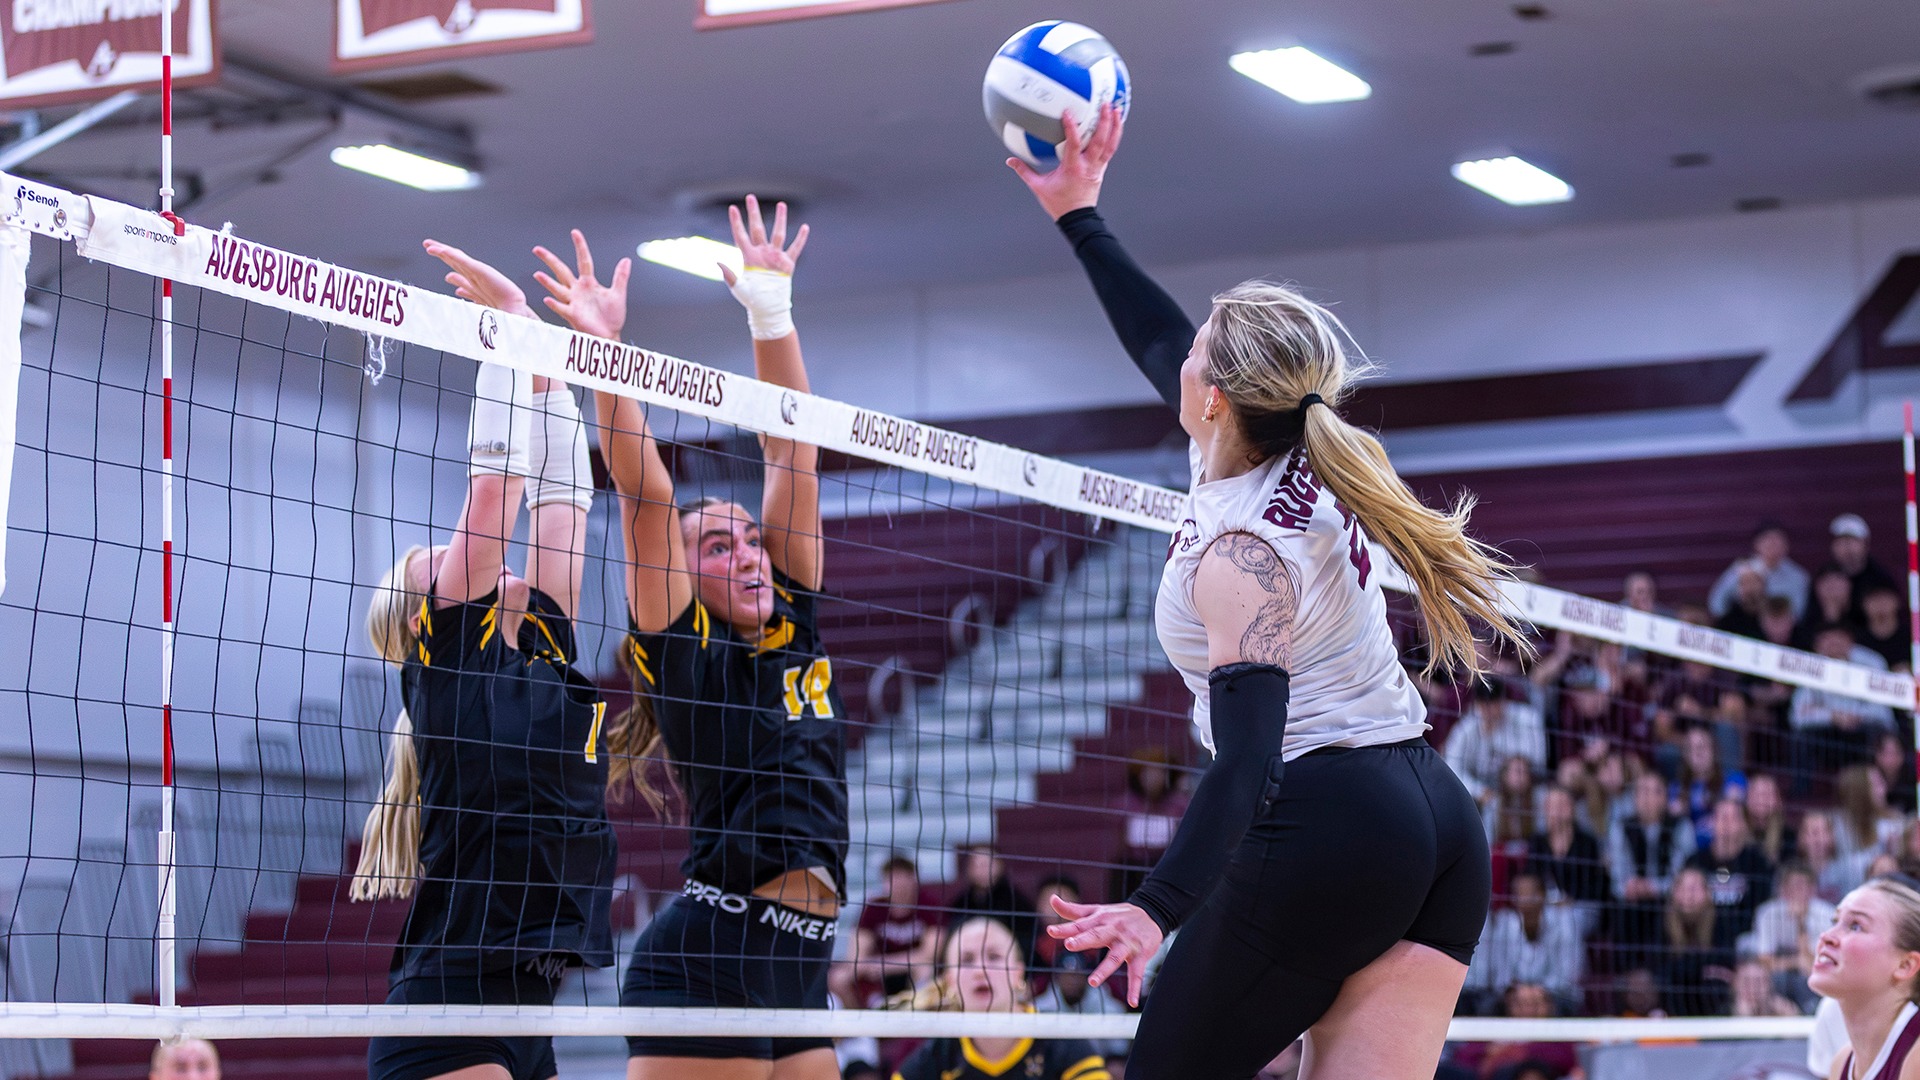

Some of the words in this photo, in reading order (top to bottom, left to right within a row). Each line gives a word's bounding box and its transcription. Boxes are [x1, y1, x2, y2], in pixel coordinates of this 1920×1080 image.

[27, 189, 60, 208] Senoh
[205, 234, 318, 304] AUGSBURG
[319, 268, 408, 327] AUGGIES
[565, 334, 655, 390] AUGSBURG
[656, 358, 726, 407] AUGGIES
[850, 410, 922, 457] AUGSBURG
[923, 430, 978, 471] AUGGIES
[1262, 447, 1322, 533] AUGS
[525, 956, 568, 978] NIK
